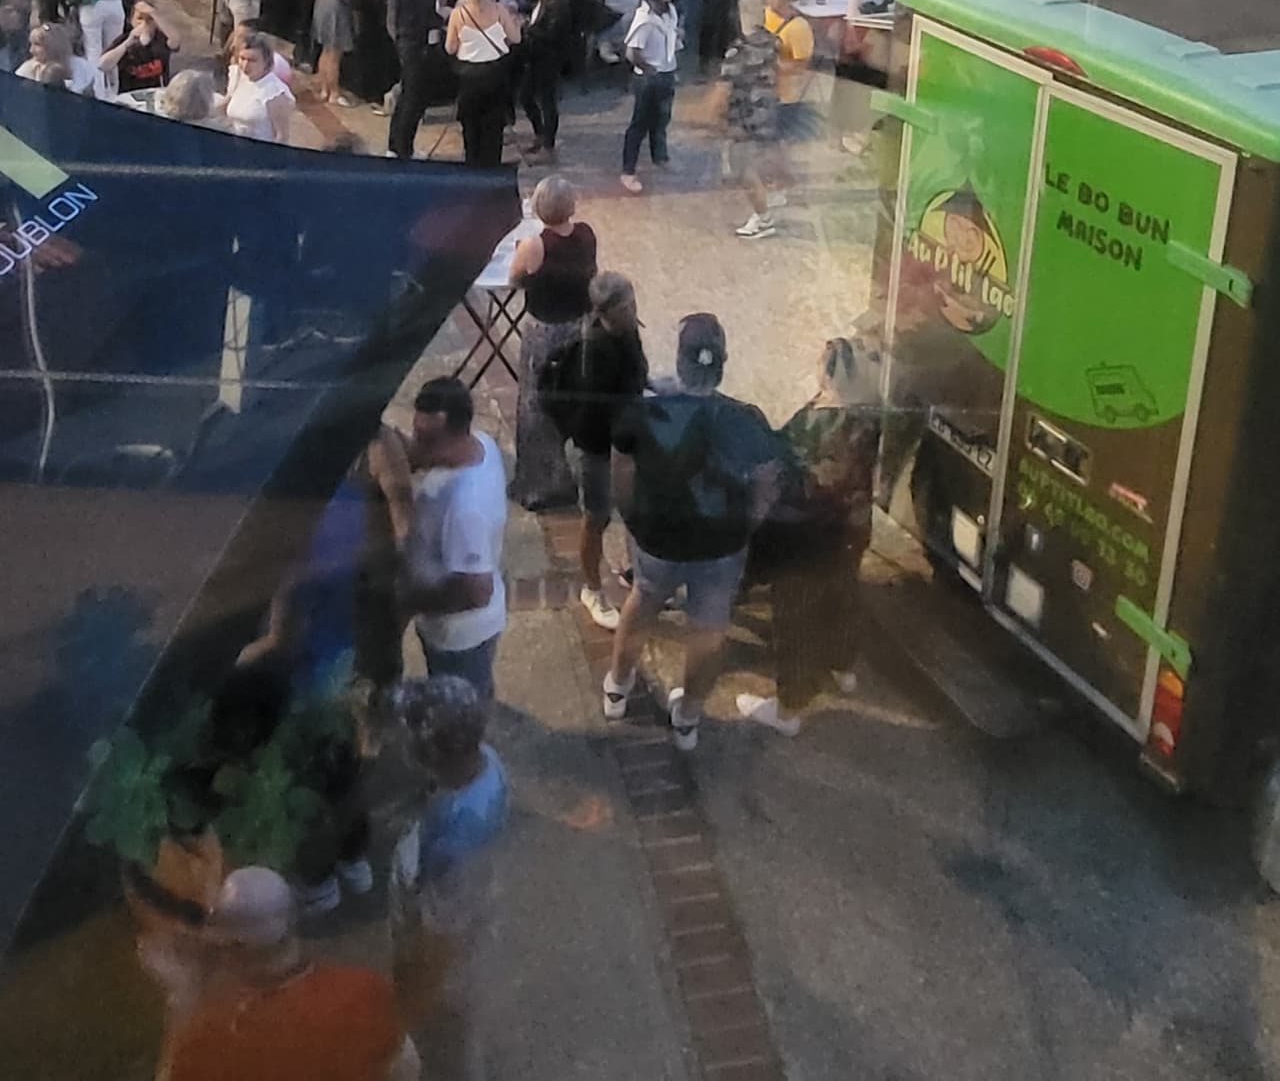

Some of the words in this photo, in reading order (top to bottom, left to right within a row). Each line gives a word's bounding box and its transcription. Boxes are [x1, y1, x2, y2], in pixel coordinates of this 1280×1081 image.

[1044, 162, 1069, 194] LE
[1077, 182, 1110, 213] BO
[1117, 201, 1170, 245] BUN
[1056, 210, 1143, 271] MAISON
